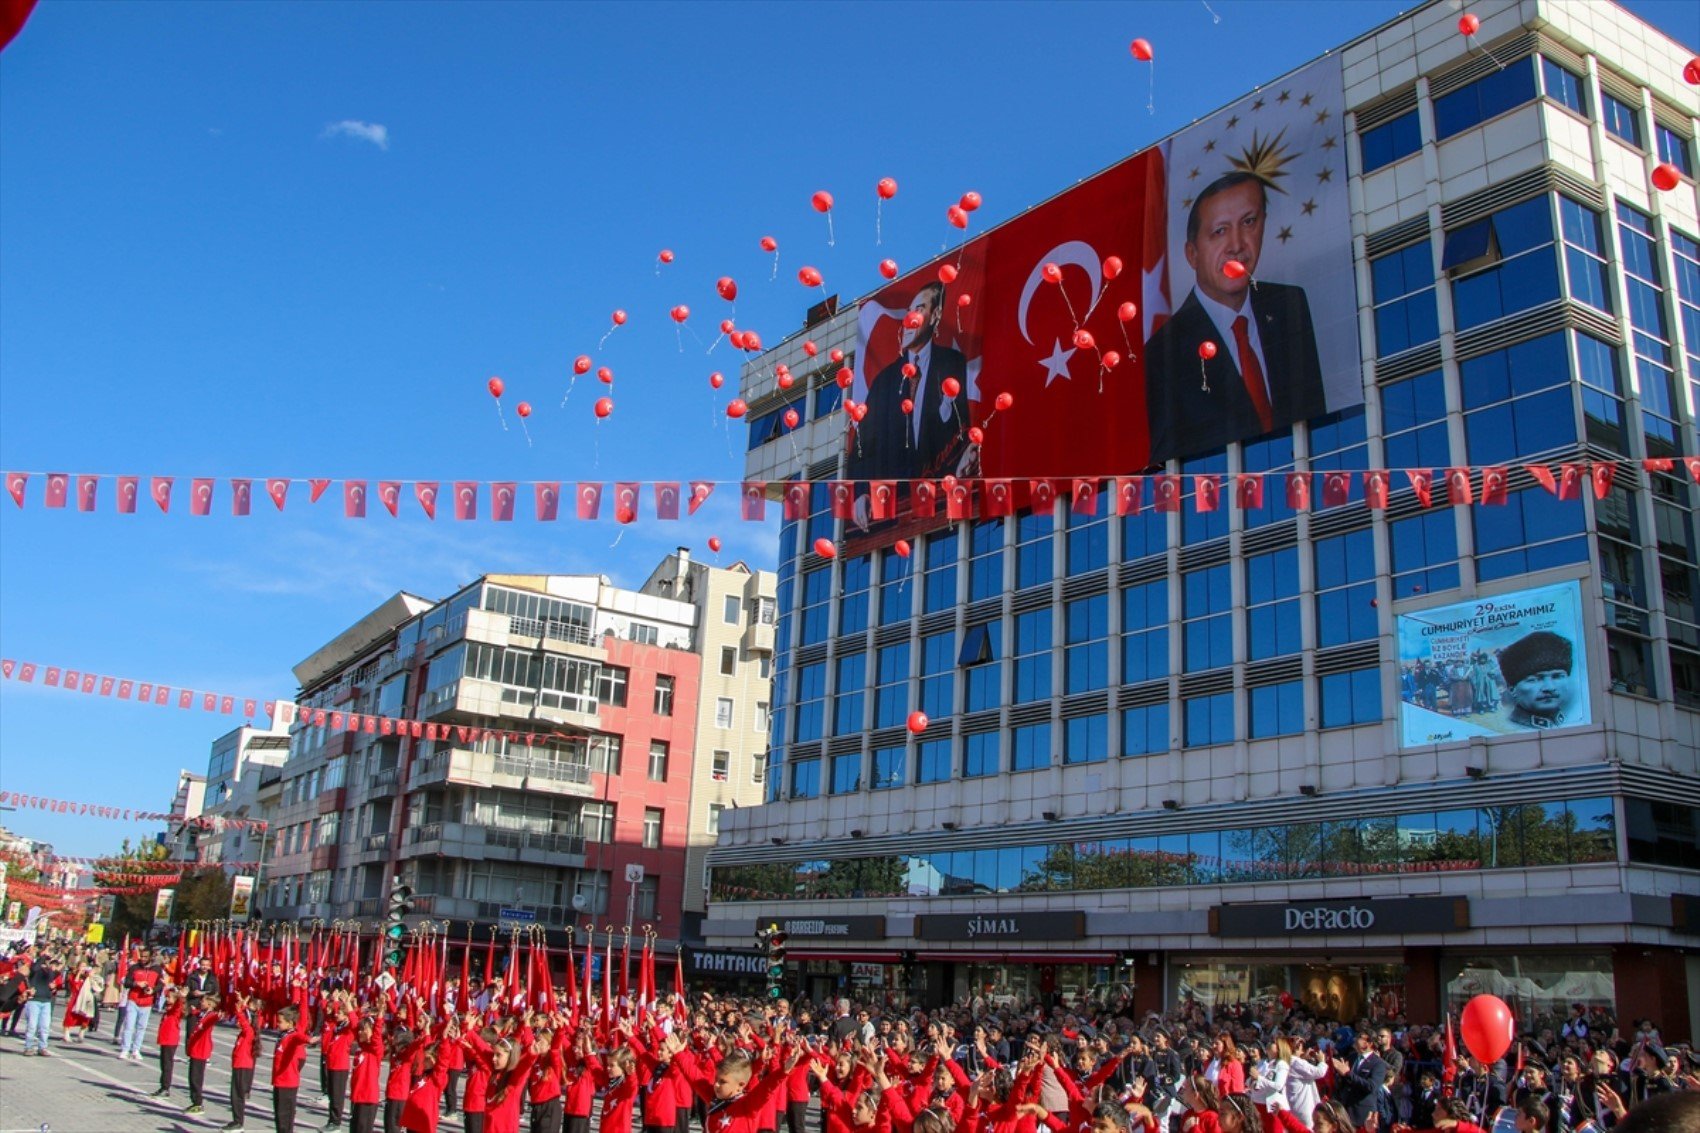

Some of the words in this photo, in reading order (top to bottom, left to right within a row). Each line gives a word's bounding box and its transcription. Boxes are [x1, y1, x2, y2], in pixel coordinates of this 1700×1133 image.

[1421, 616, 1485, 636] CUMHURİYET
[1488, 602, 1556, 624] BAYRAMIMIZ
[1475, 602, 1494, 616] 29
[967, 915, 1019, 937] ŞİMAL
[1284, 905, 1375, 931] DeFacto
